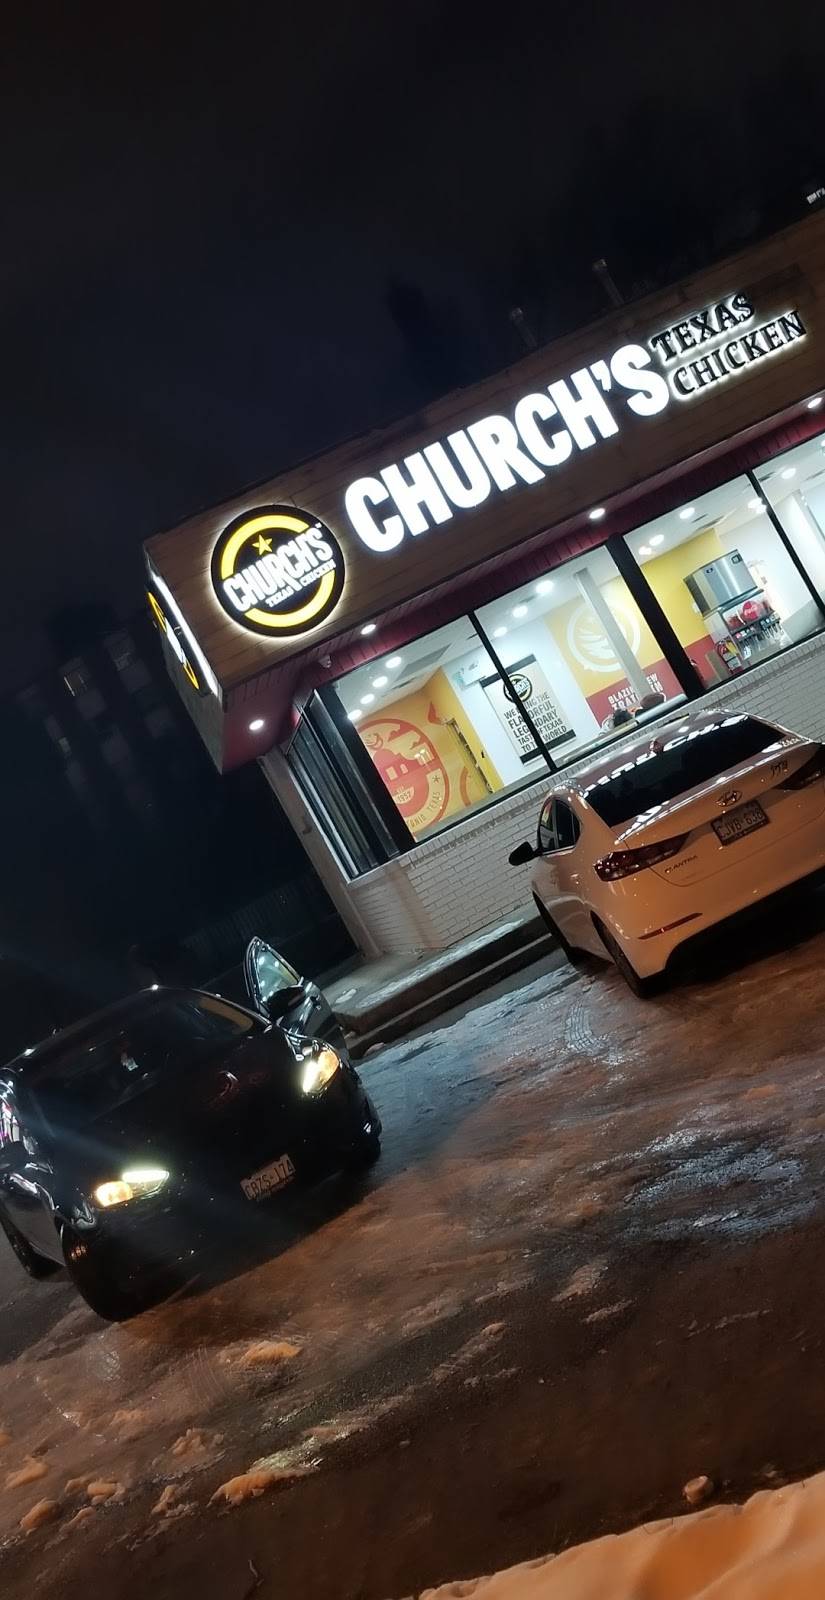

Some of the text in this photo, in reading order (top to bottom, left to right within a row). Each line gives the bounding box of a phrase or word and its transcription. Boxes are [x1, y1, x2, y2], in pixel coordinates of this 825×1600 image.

[650, 293, 755, 362] TEXAS
[672, 311, 807, 397] CHICKEN
[344, 343, 671, 553] CHURCH'S
[223, 527, 334, 612] CHURCH'S
[265, 559, 337, 608] TEXAS CHICKEN
[646, 673, 658, 685] EW
[504, 708, 517, 720] WE
[536, 691, 550, 703] THE
[508, 700, 555, 729] FLAORFUL
[513, 709, 558, 738] LEGNDARY
[518, 733, 534, 746] TAST
[543, 719, 564, 732] TEXAS
[521, 743, 531, 753] TO
[543, 725, 567, 742] WORLD
